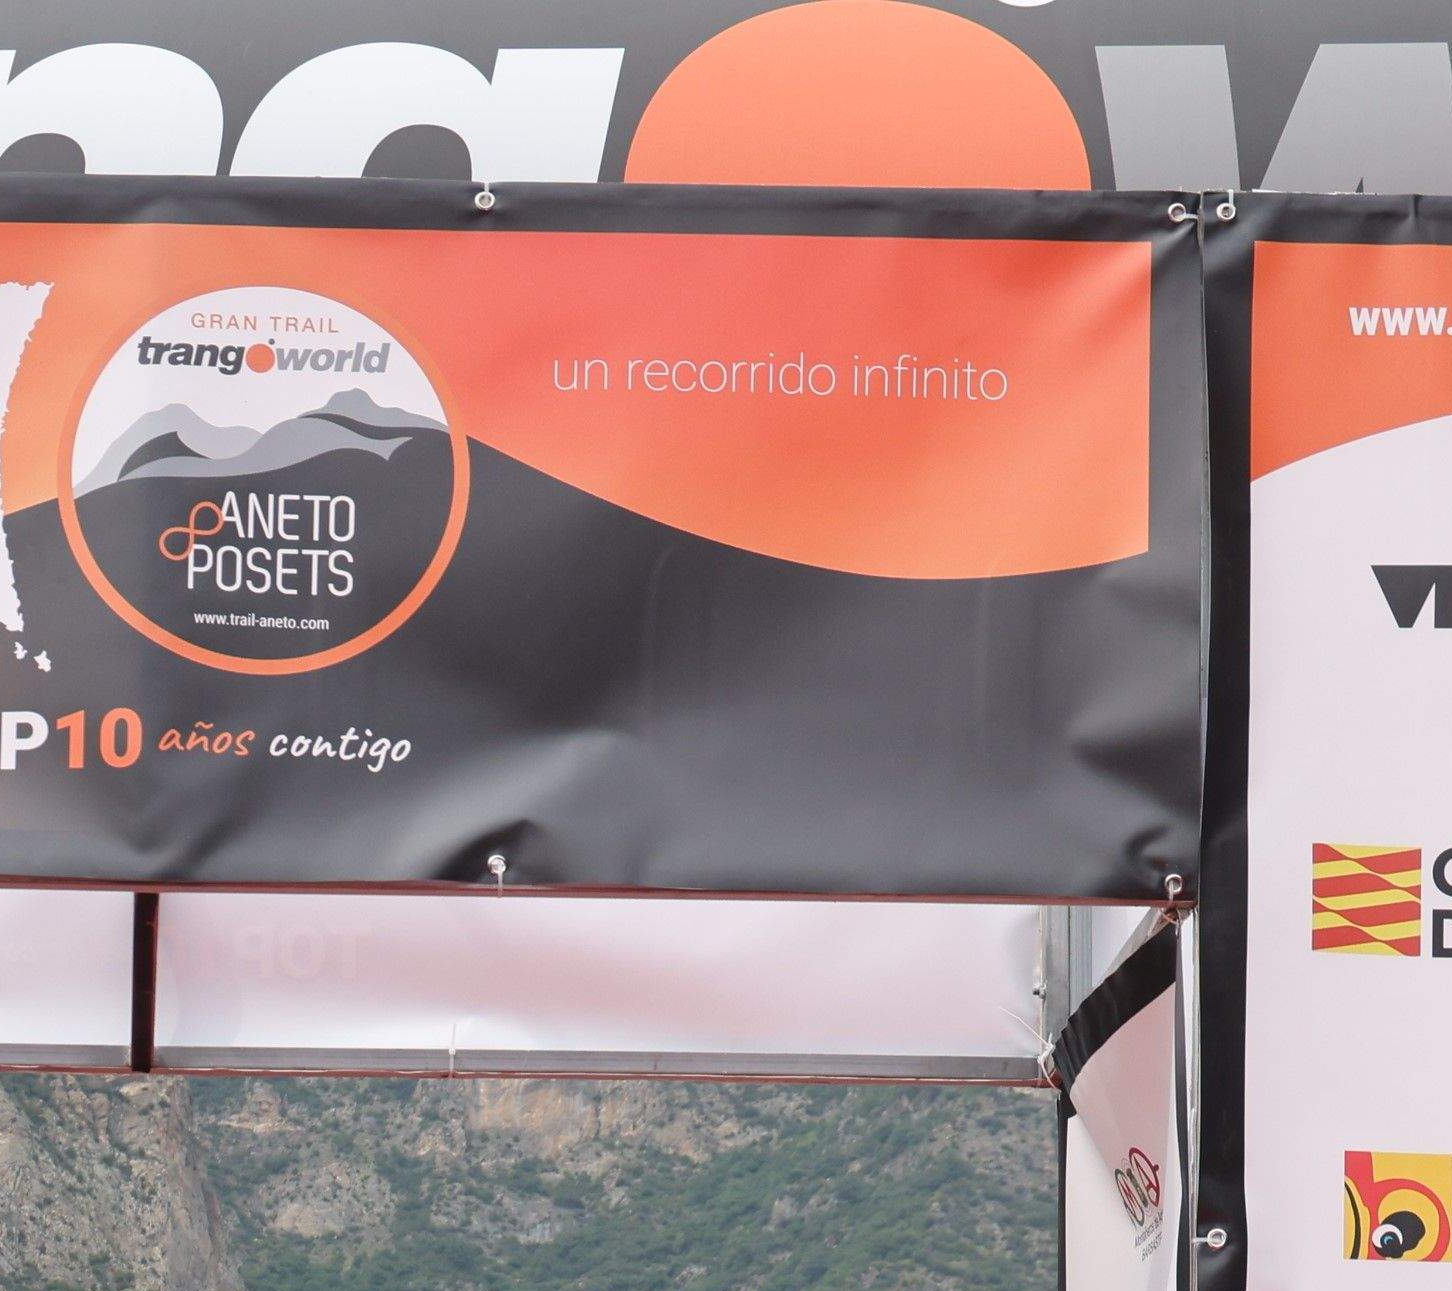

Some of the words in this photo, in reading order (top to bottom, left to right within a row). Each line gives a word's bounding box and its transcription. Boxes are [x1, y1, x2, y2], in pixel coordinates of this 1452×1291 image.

[190, 312, 260, 331] GRAN
[269, 314, 339, 333] TRAIL
[552, 357, 611, 392] un
[623, 352, 837, 396] recorrido
[853, 354, 1009, 402] infinito
[219, 491, 356, 543] ANETO
[188, 545, 355, 597] POSETS
[193, 610, 331, 632] www.trail-aneto.com
[157, 719, 255, 757] años
[269, 722, 412, 774] contigo
